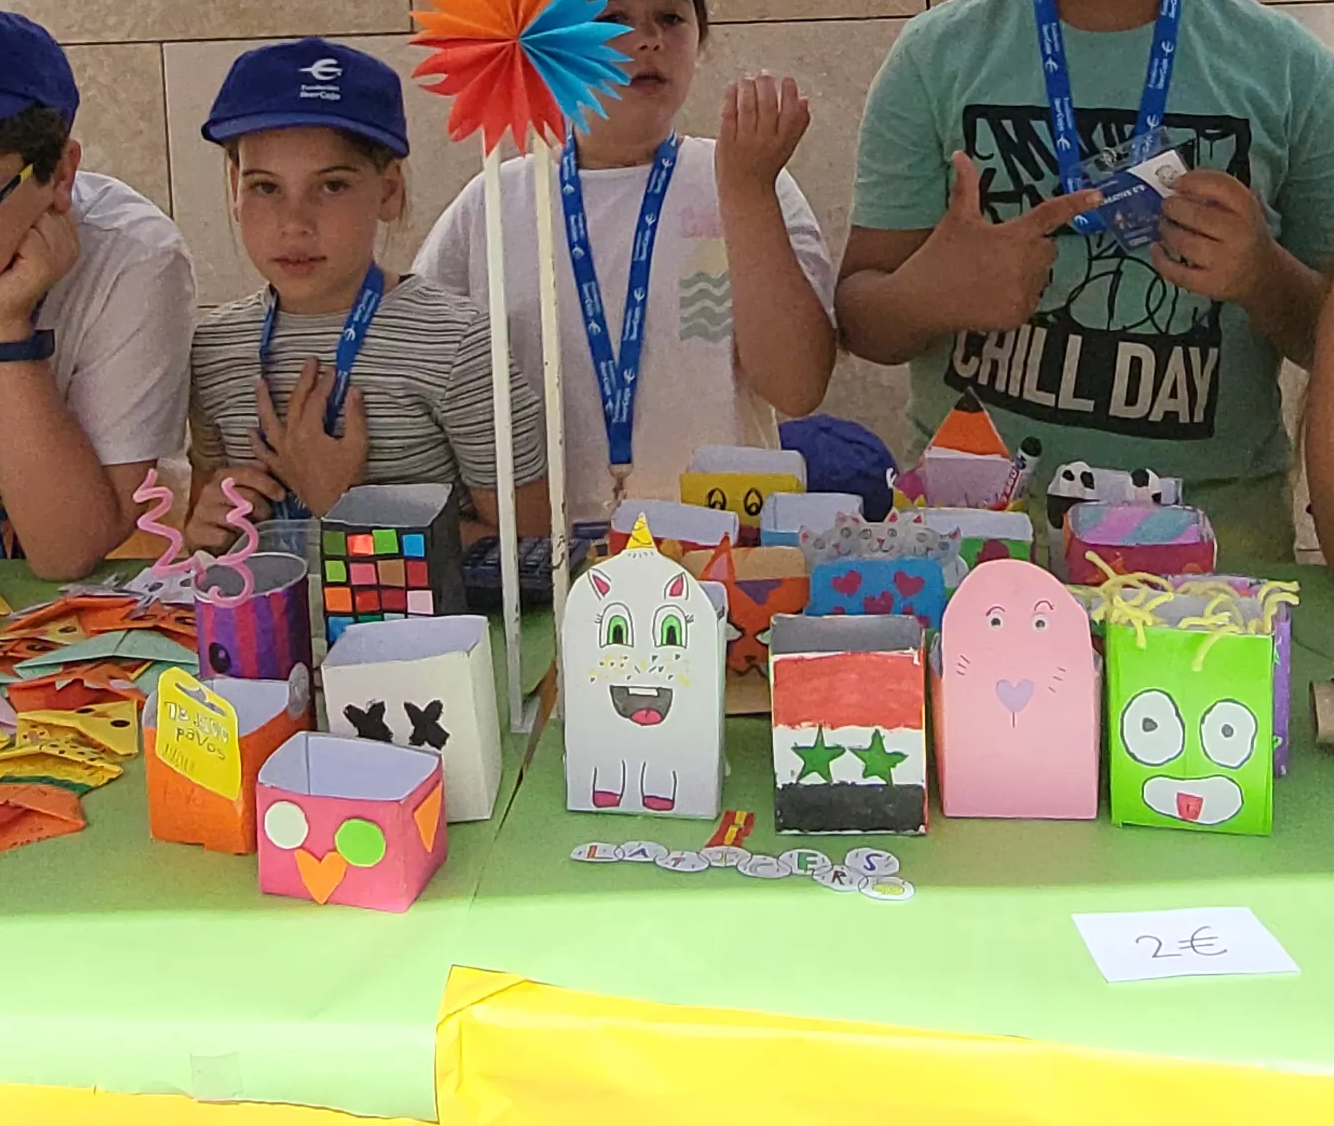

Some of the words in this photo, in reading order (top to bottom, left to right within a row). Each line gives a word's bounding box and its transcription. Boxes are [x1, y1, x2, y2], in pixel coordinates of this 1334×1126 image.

[952, 326, 1095, 413] CHILL
[1108, 341, 1219, 424] DAY
[1135, 925, 1228, 958] 2€
